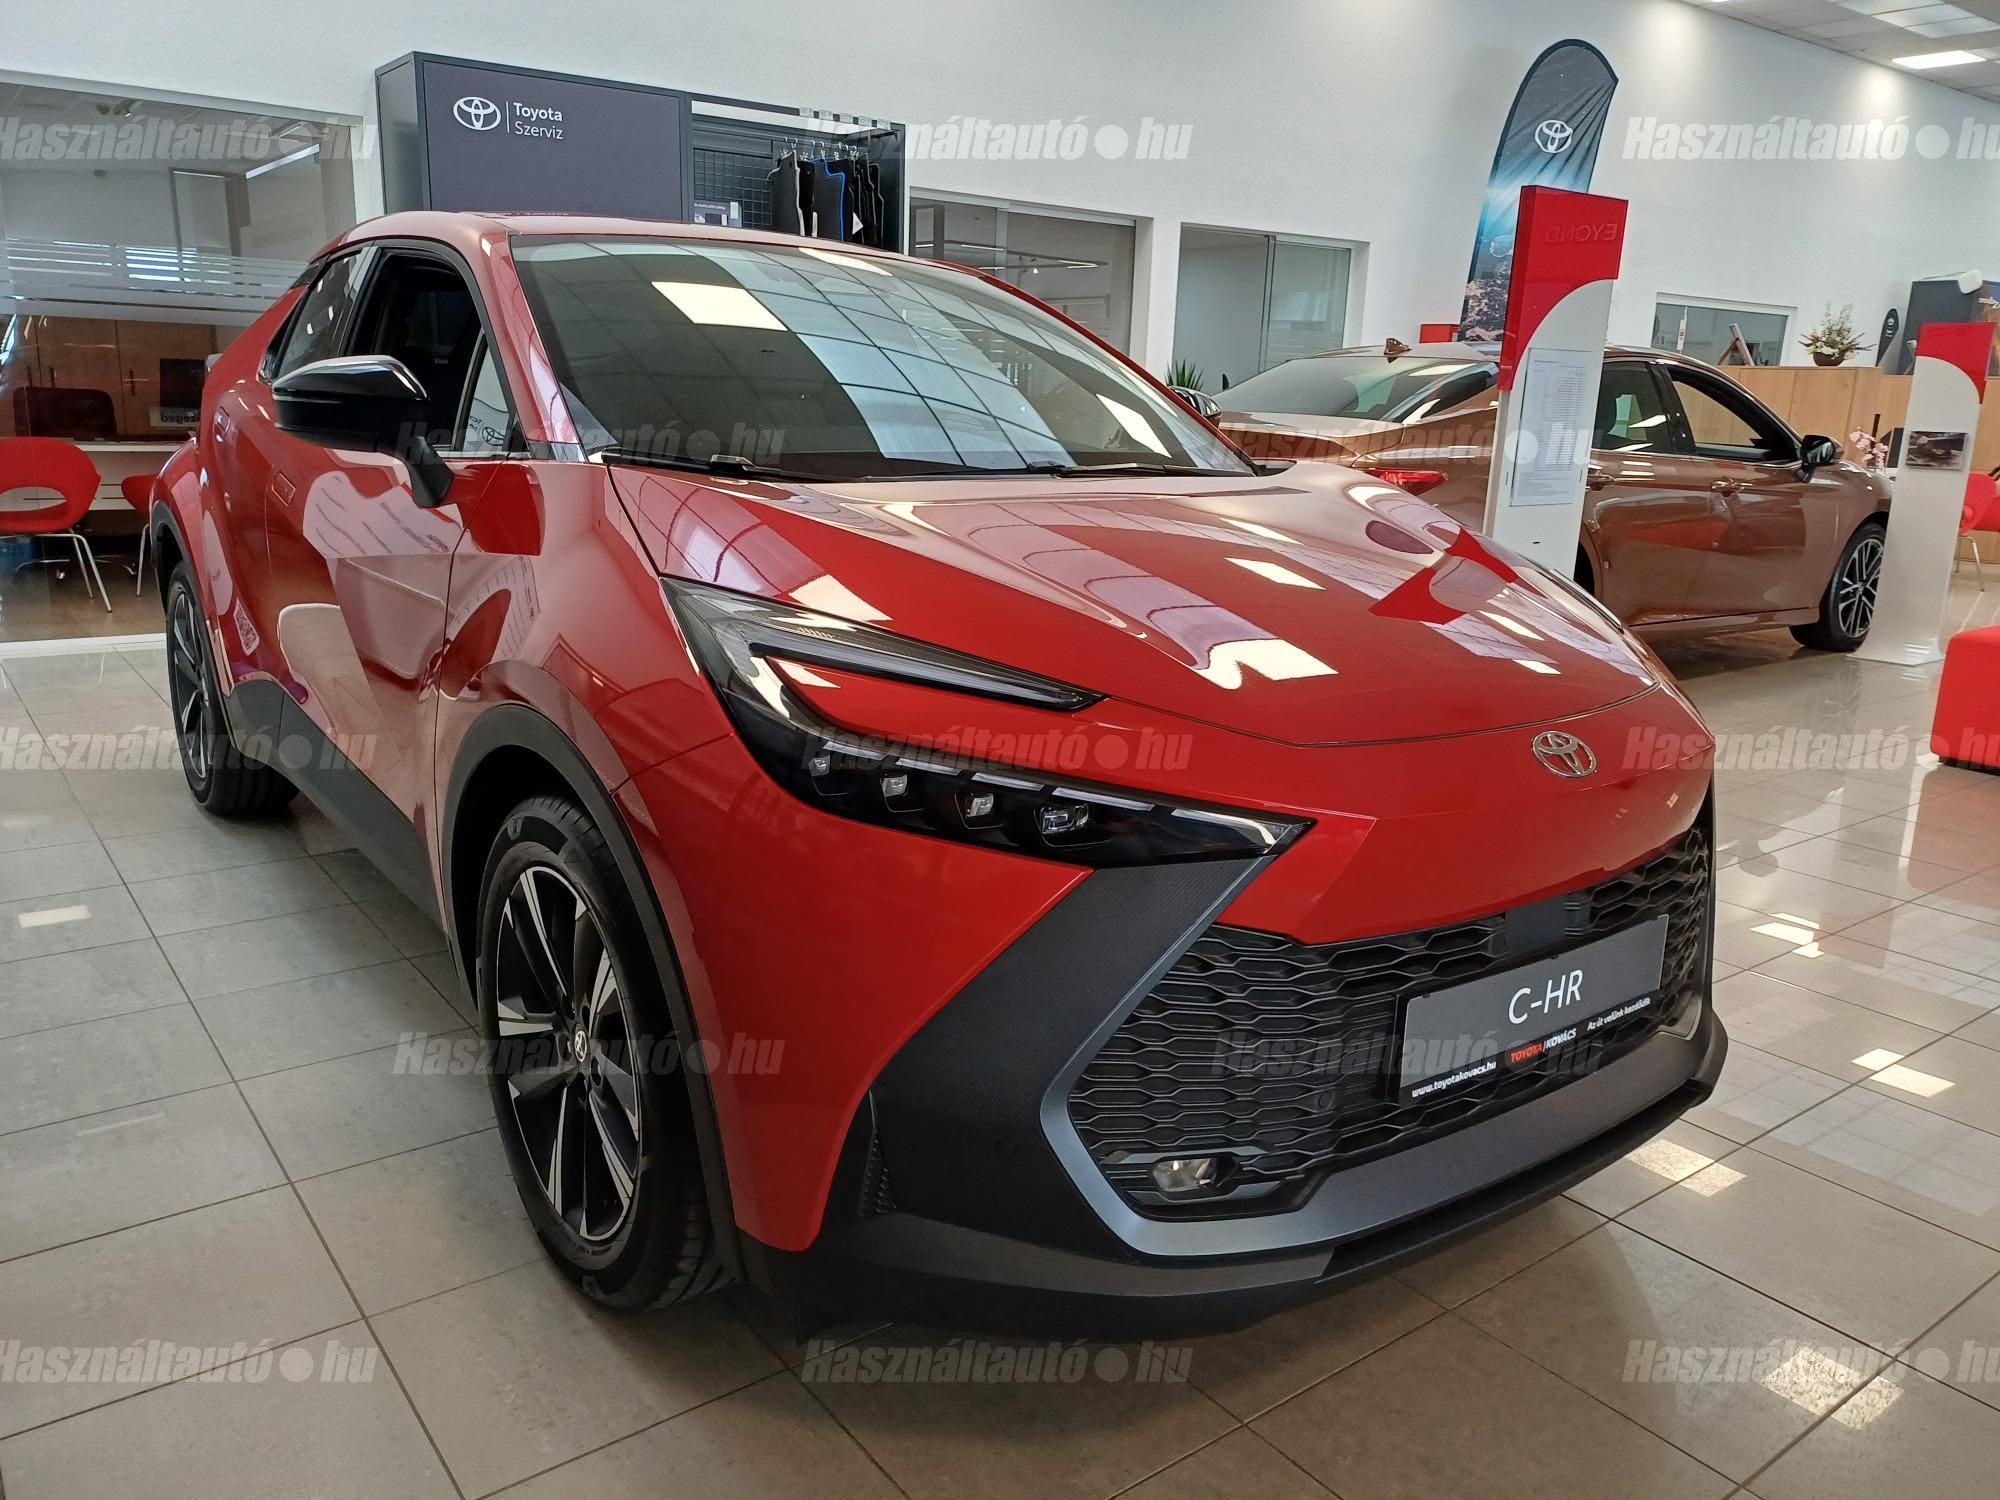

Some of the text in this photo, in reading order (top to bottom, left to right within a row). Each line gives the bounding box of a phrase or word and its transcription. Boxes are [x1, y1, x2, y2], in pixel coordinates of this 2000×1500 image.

[513, 102, 563, 121] Toyota
[515, 121, 564, 139] Szerviz
[1508, 969, 1583, 1025] C-HR
[1412, 1061, 1496, 1097] www.toyotakovacs.hu
